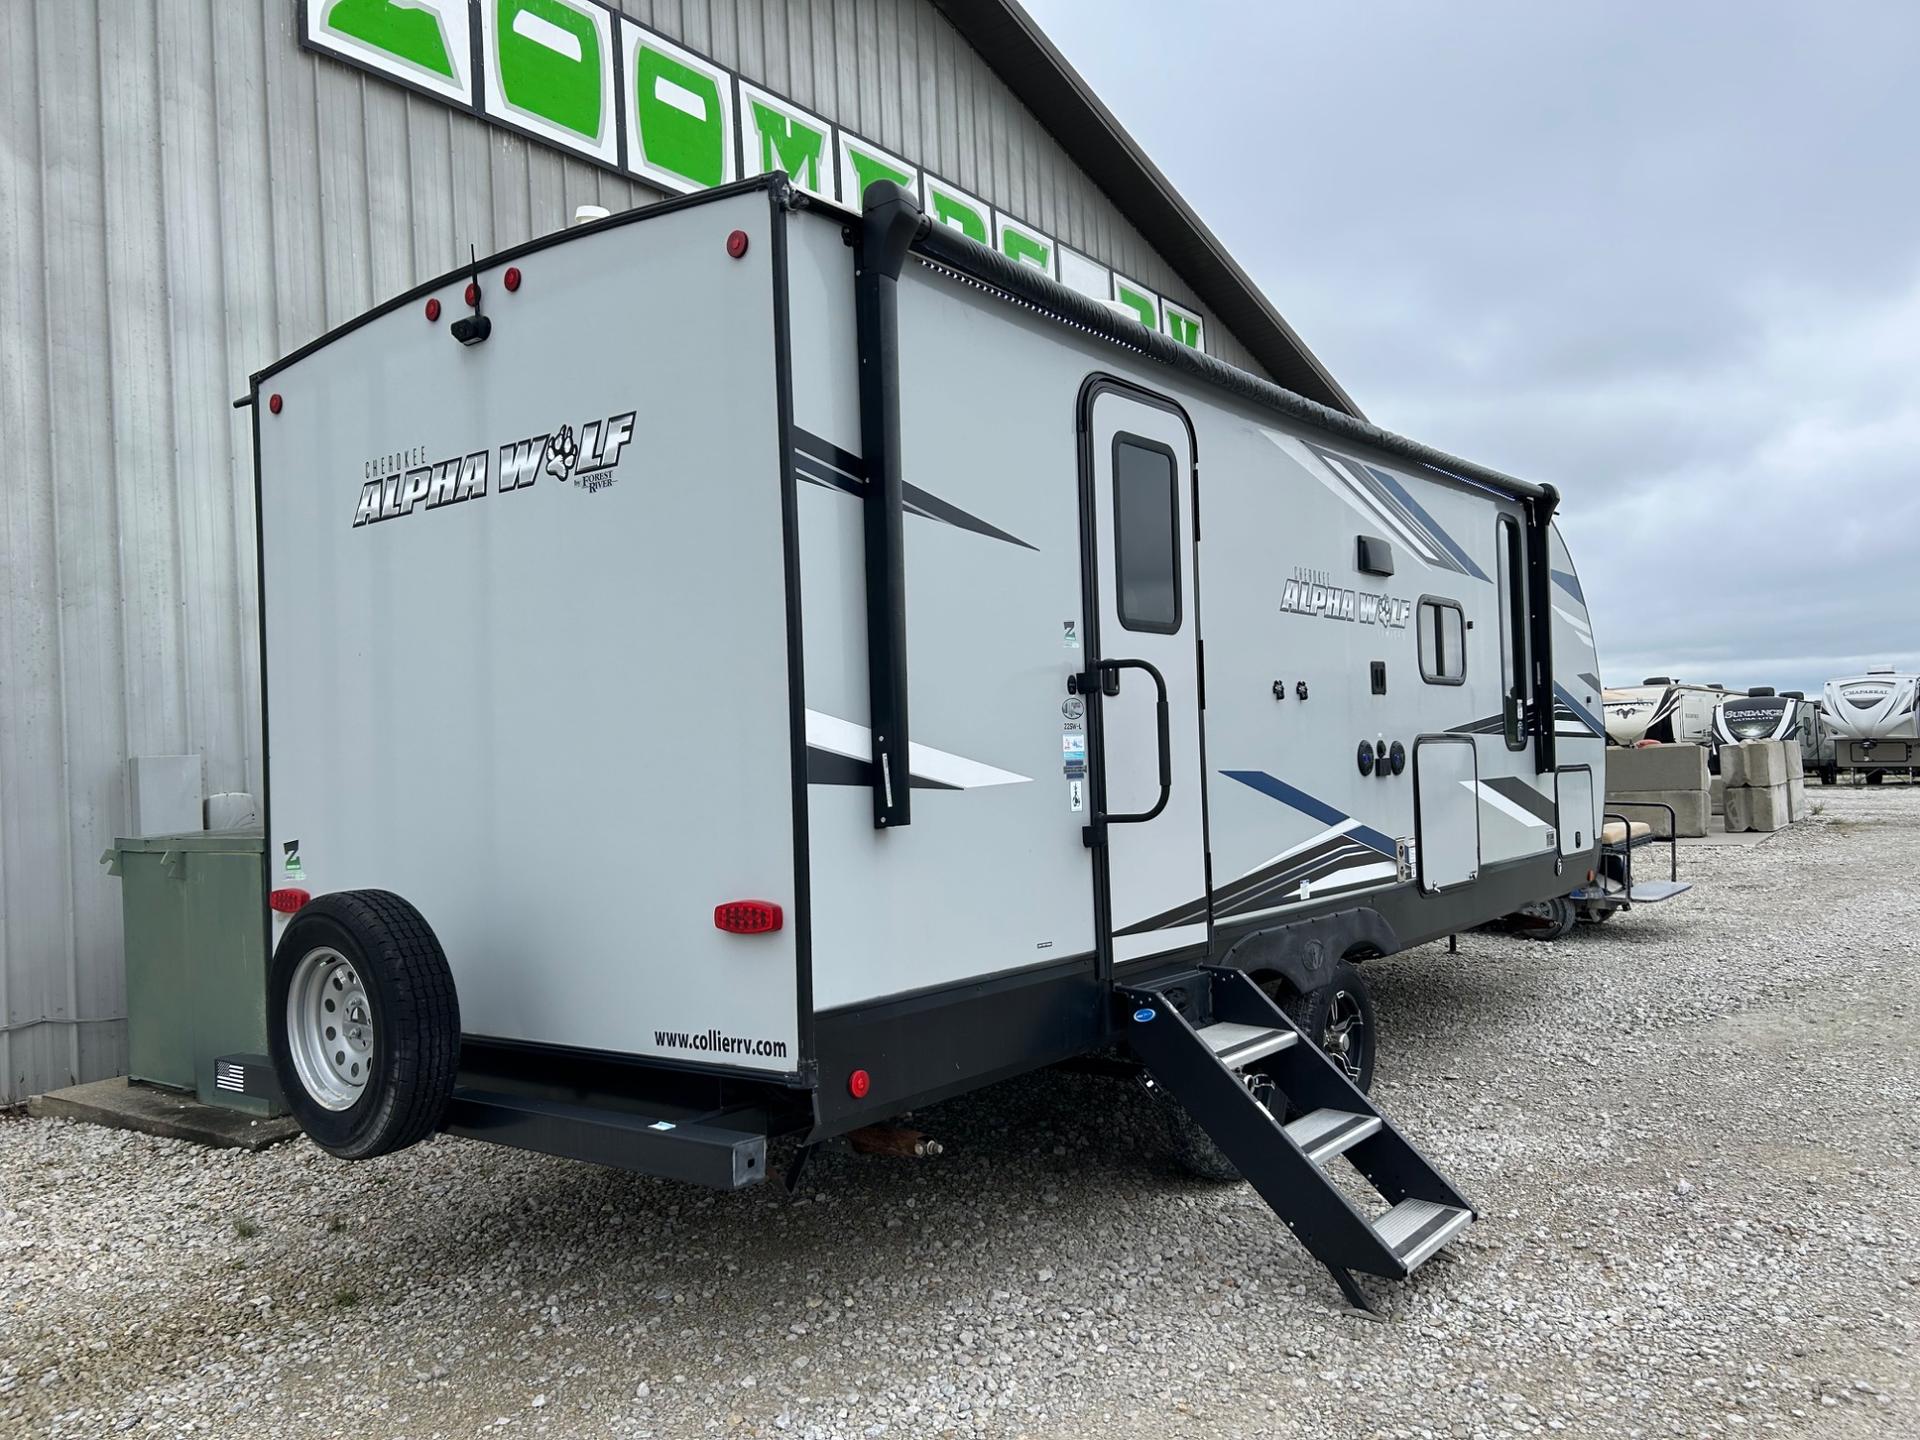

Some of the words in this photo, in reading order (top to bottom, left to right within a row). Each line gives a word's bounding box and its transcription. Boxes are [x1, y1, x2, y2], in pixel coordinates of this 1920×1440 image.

[365, 446, 425, 479] CHEROKEE
[352, 449, 489, 528] ALPHA
[582, 470, 613, 488] FOREST
[589, 479, 614, 493] RIVER
[1280, 578, 1355, 622] ALPHA
[1724, 709, 1784, 719] SUNDANCE
[654, 1029, 787, 1058] www.collierrv.com
